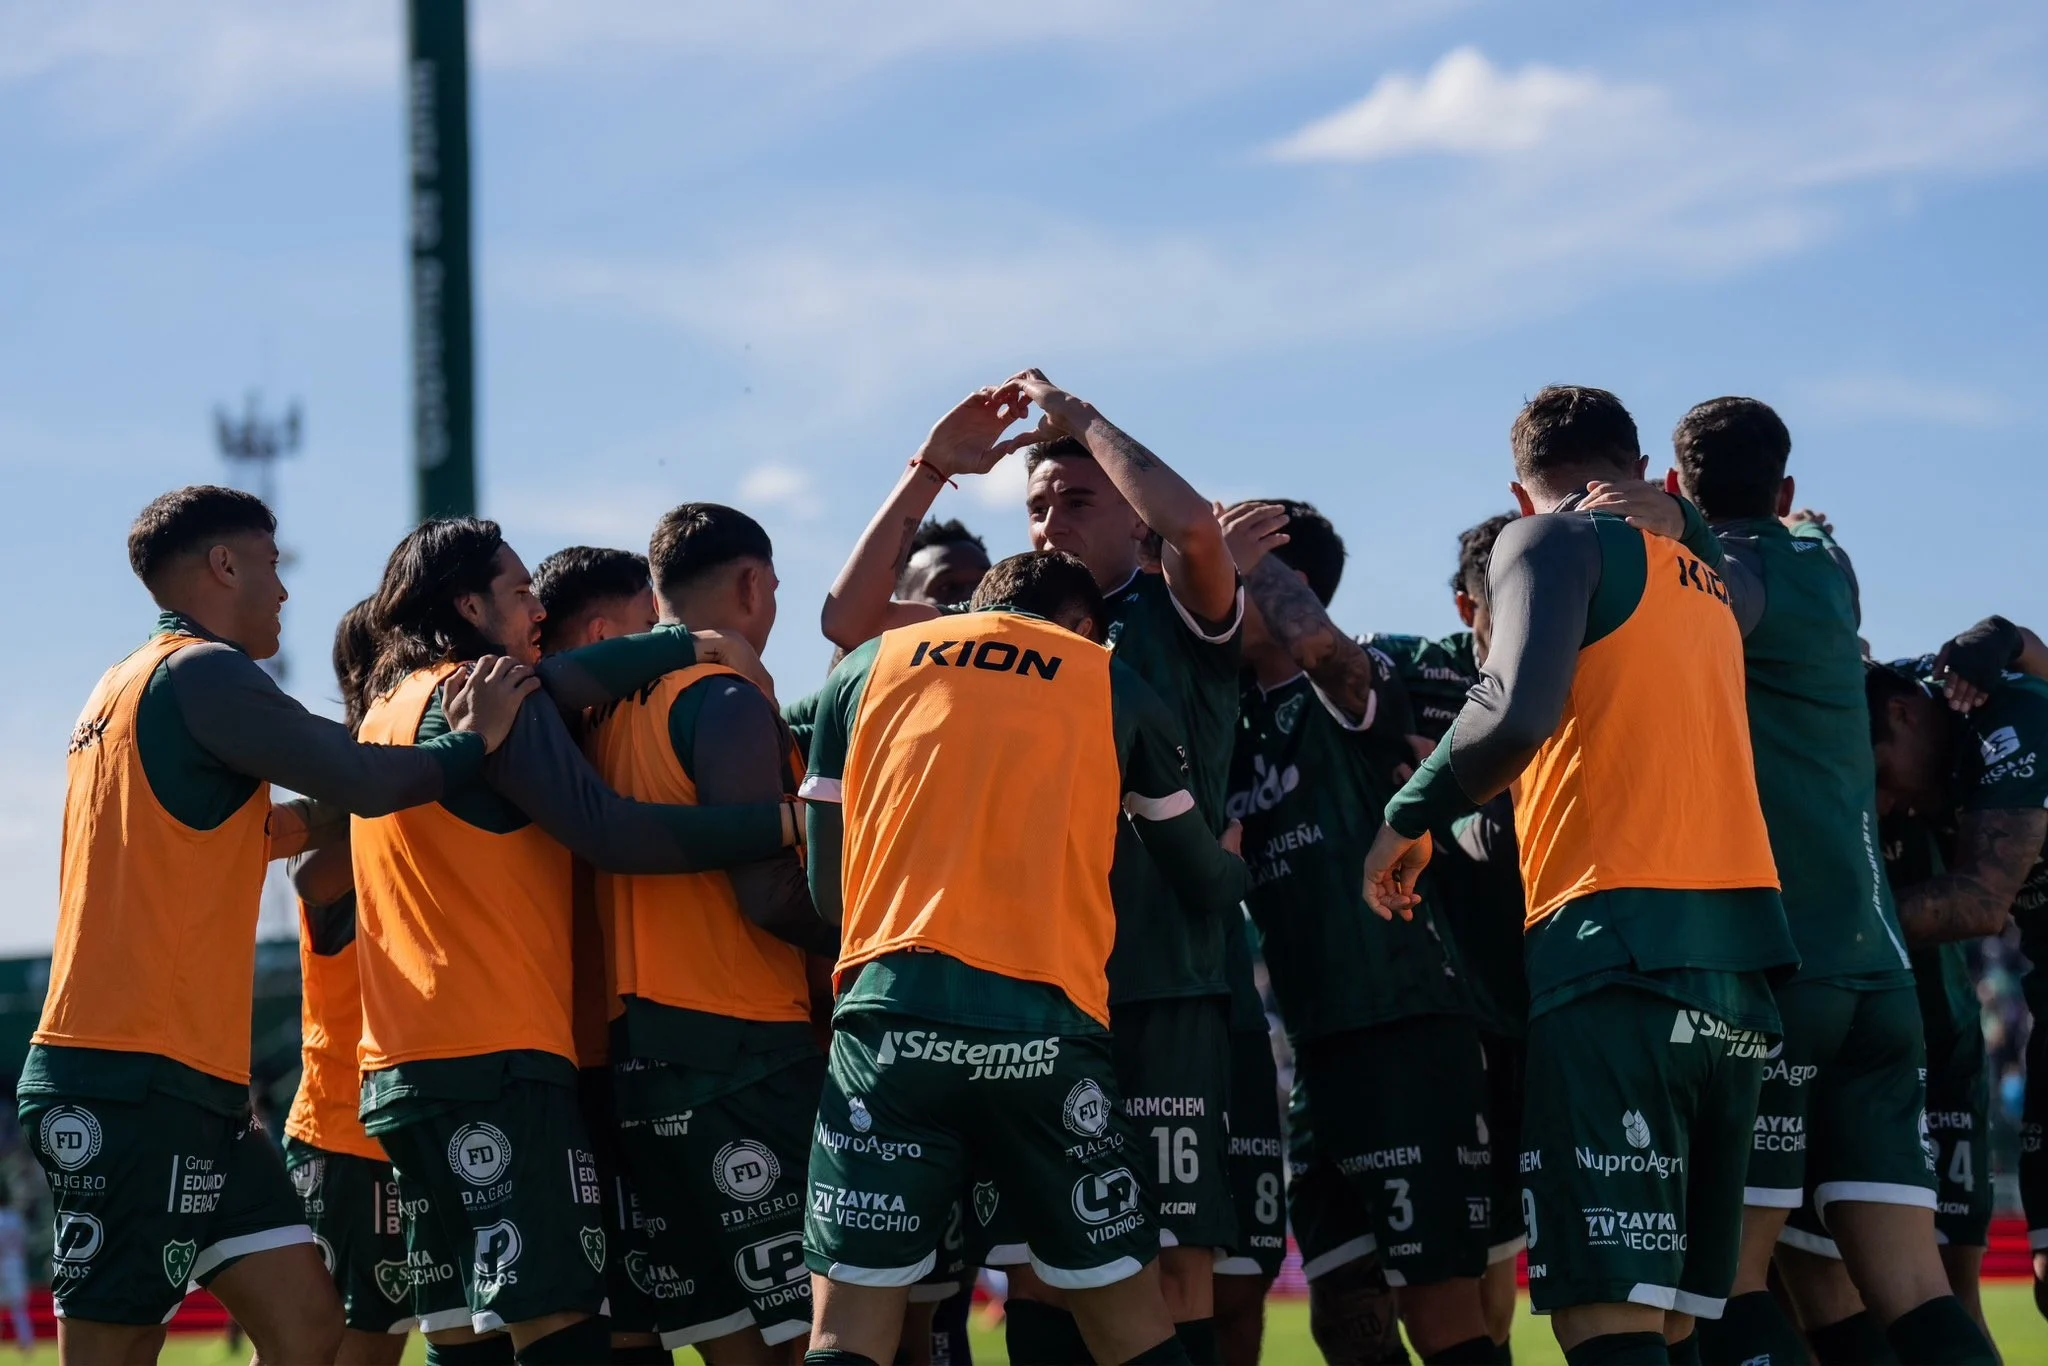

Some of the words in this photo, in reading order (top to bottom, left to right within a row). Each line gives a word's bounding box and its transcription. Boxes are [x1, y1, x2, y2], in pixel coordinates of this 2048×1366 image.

[1677, 556, 1731, 606] KIO
[910, 640, 1063, 681] KION
[1264, 822, 1324, 860] QUEÑA
[900, 1030, 1061, 1066] Sistemas
[968, 1060, 1056, 1081] JUNIN
[1761, 1058, 1819, 1086] oAgro
[1124, 1096, 1205, 1117] ARMCHEM
[1753, 1115, 1804, 1134] AYKA
[1928, 1111, 1973, 1130] CHEM
[55, 1131, 82, 1149] FD
[817, 1121, 922, 1161] NuproAgro
[185, 1155, 214, 1174] Grup
[467, 1145, 494, 1166] FD
[1150, 1126, 1199, 1184] 16
[1457, 1146, 1491, 1170] Nupro
[731, 1161, 762, 1183] FD
[461, 1179, 513, 1205] DAGRO
[836, 1187, 906, 1213] ZAYKA
[1254, 1171, 1280, 1225] 8
[1384, 1178, 1414, 1231] 3
[836, 1207, 921, 1233] VECCHIO
[1160, 1201, 1197, 1215] KION
[1086, 1213, 1145, 1245] VIDRIOS
[1388, 1242, 1423, 1257] KION
[654, 1279, 695, 1299] CCHIO
[753, 1283, 812, 1311] VIDRIO
